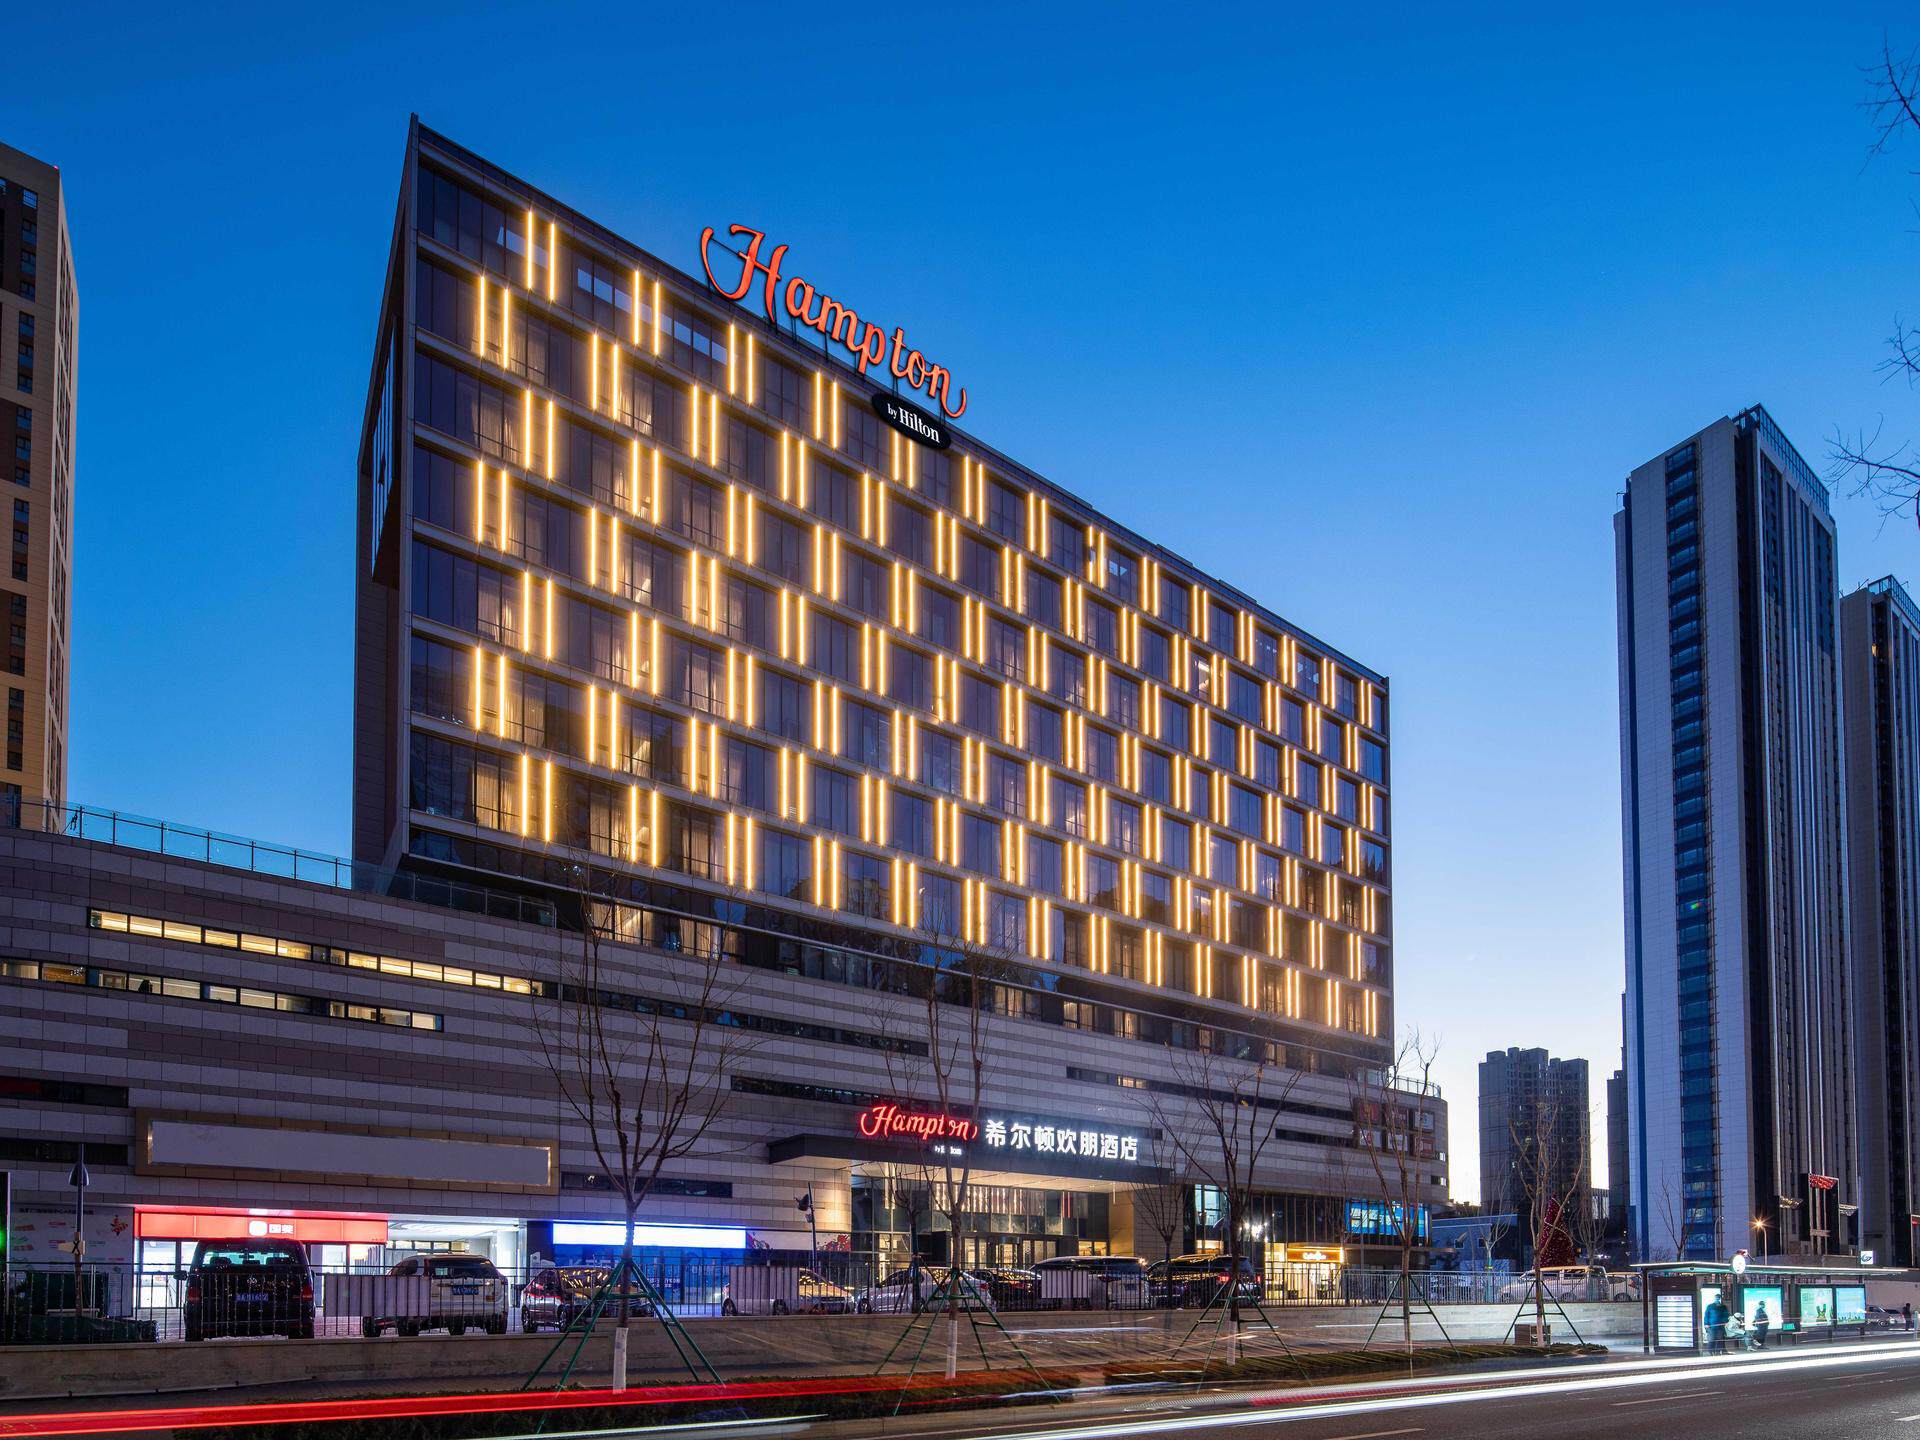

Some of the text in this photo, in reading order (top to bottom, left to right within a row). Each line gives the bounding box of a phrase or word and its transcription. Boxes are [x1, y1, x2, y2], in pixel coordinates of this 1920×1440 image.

[701, 224, 967, 418] Hampton
[887, 402, 941, 444] by Hilton
[860, 1103, 978, 1141] Hampton
[985, 1119, 1138, 1161] 希尔顿欢朋酒店
